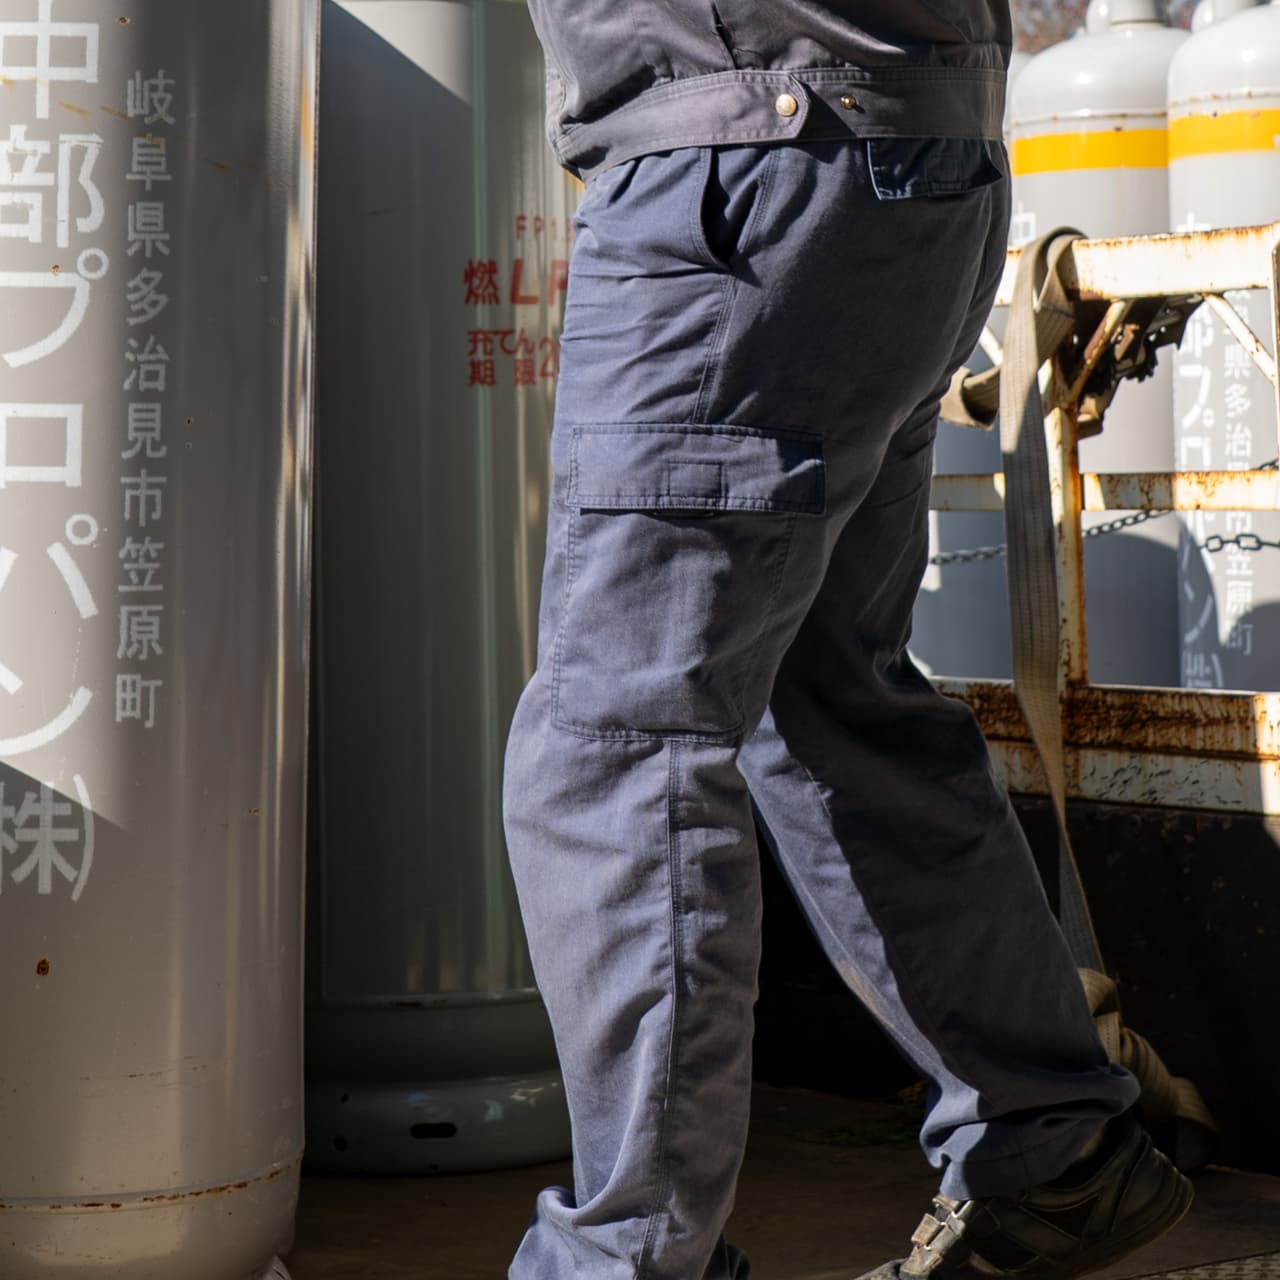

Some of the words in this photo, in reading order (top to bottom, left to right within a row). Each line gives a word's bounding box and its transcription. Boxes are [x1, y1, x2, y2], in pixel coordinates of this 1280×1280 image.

[113, 69, 177, 729] 岐阜県多治見市笠原町
